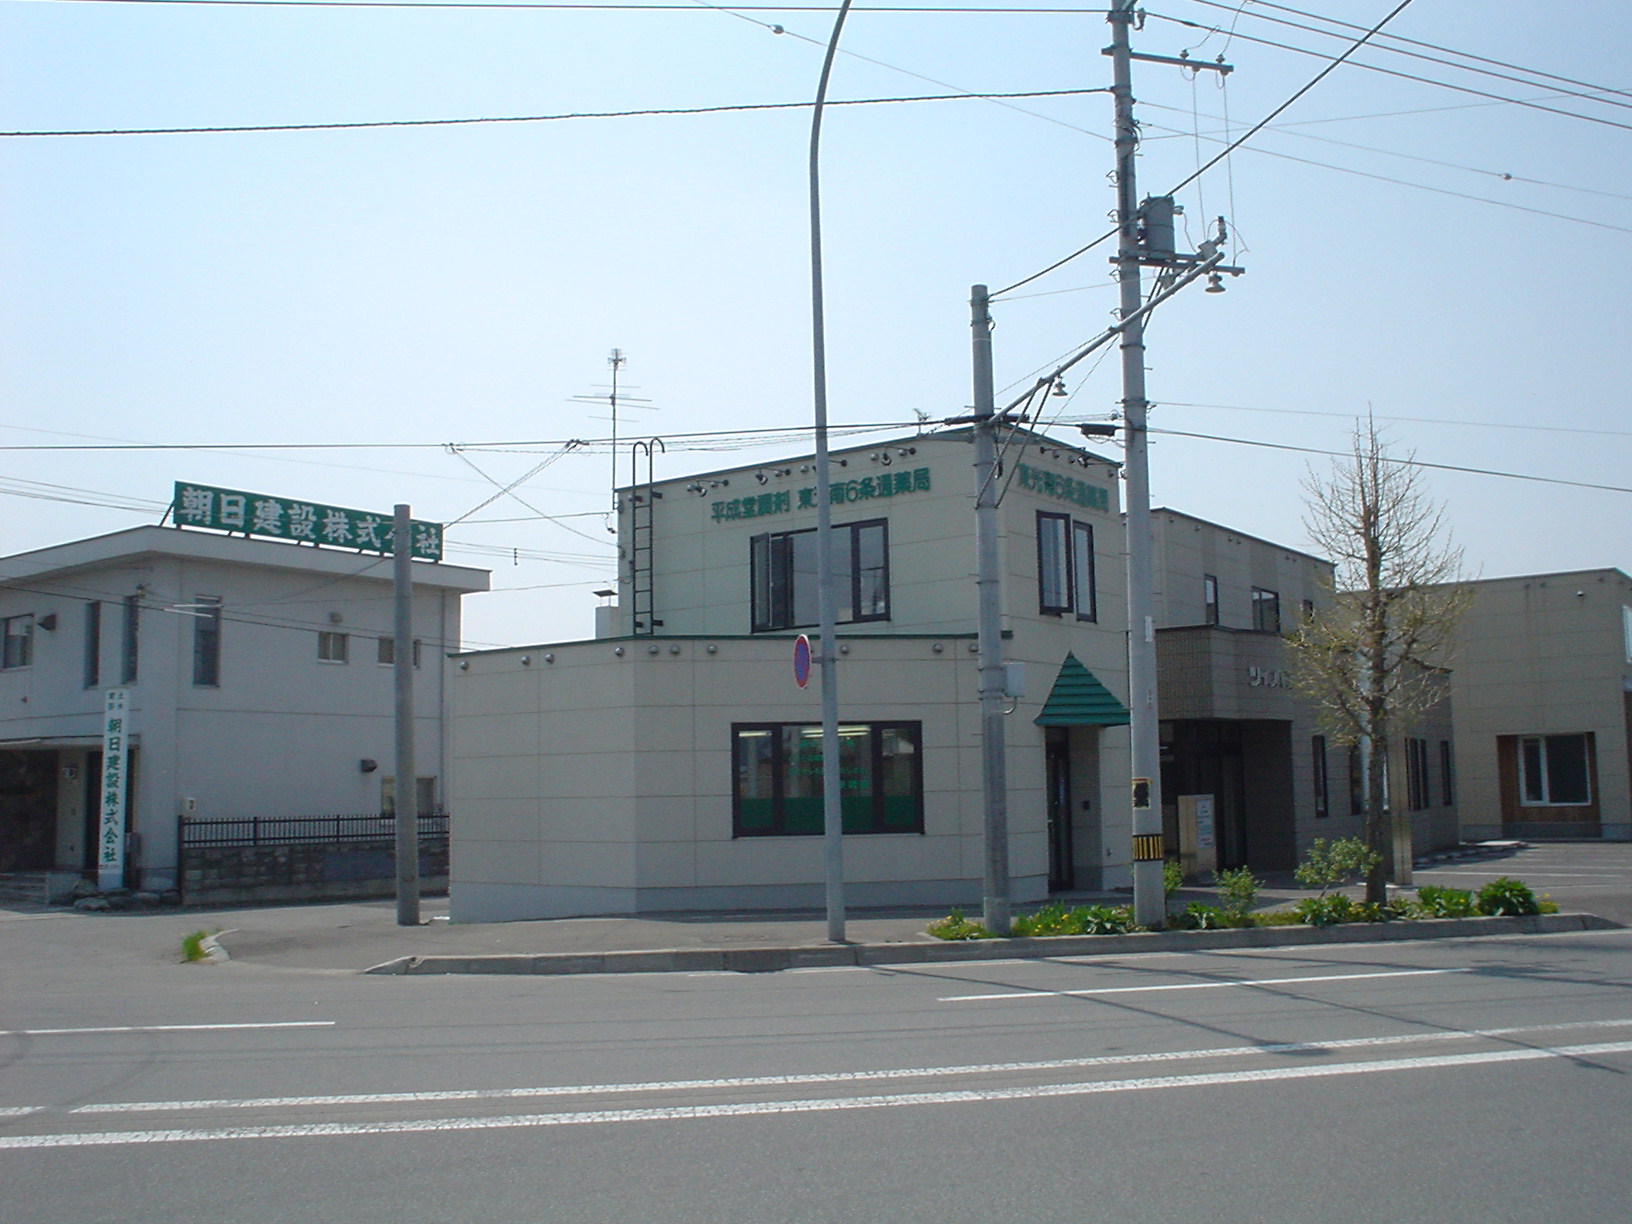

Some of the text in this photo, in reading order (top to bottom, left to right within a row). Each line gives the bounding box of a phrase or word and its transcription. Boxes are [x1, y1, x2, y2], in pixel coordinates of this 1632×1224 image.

[797, 466, 931, 511] 東南6条通薬局
[103, 718, 122, 863] 朝日建設株式会社
